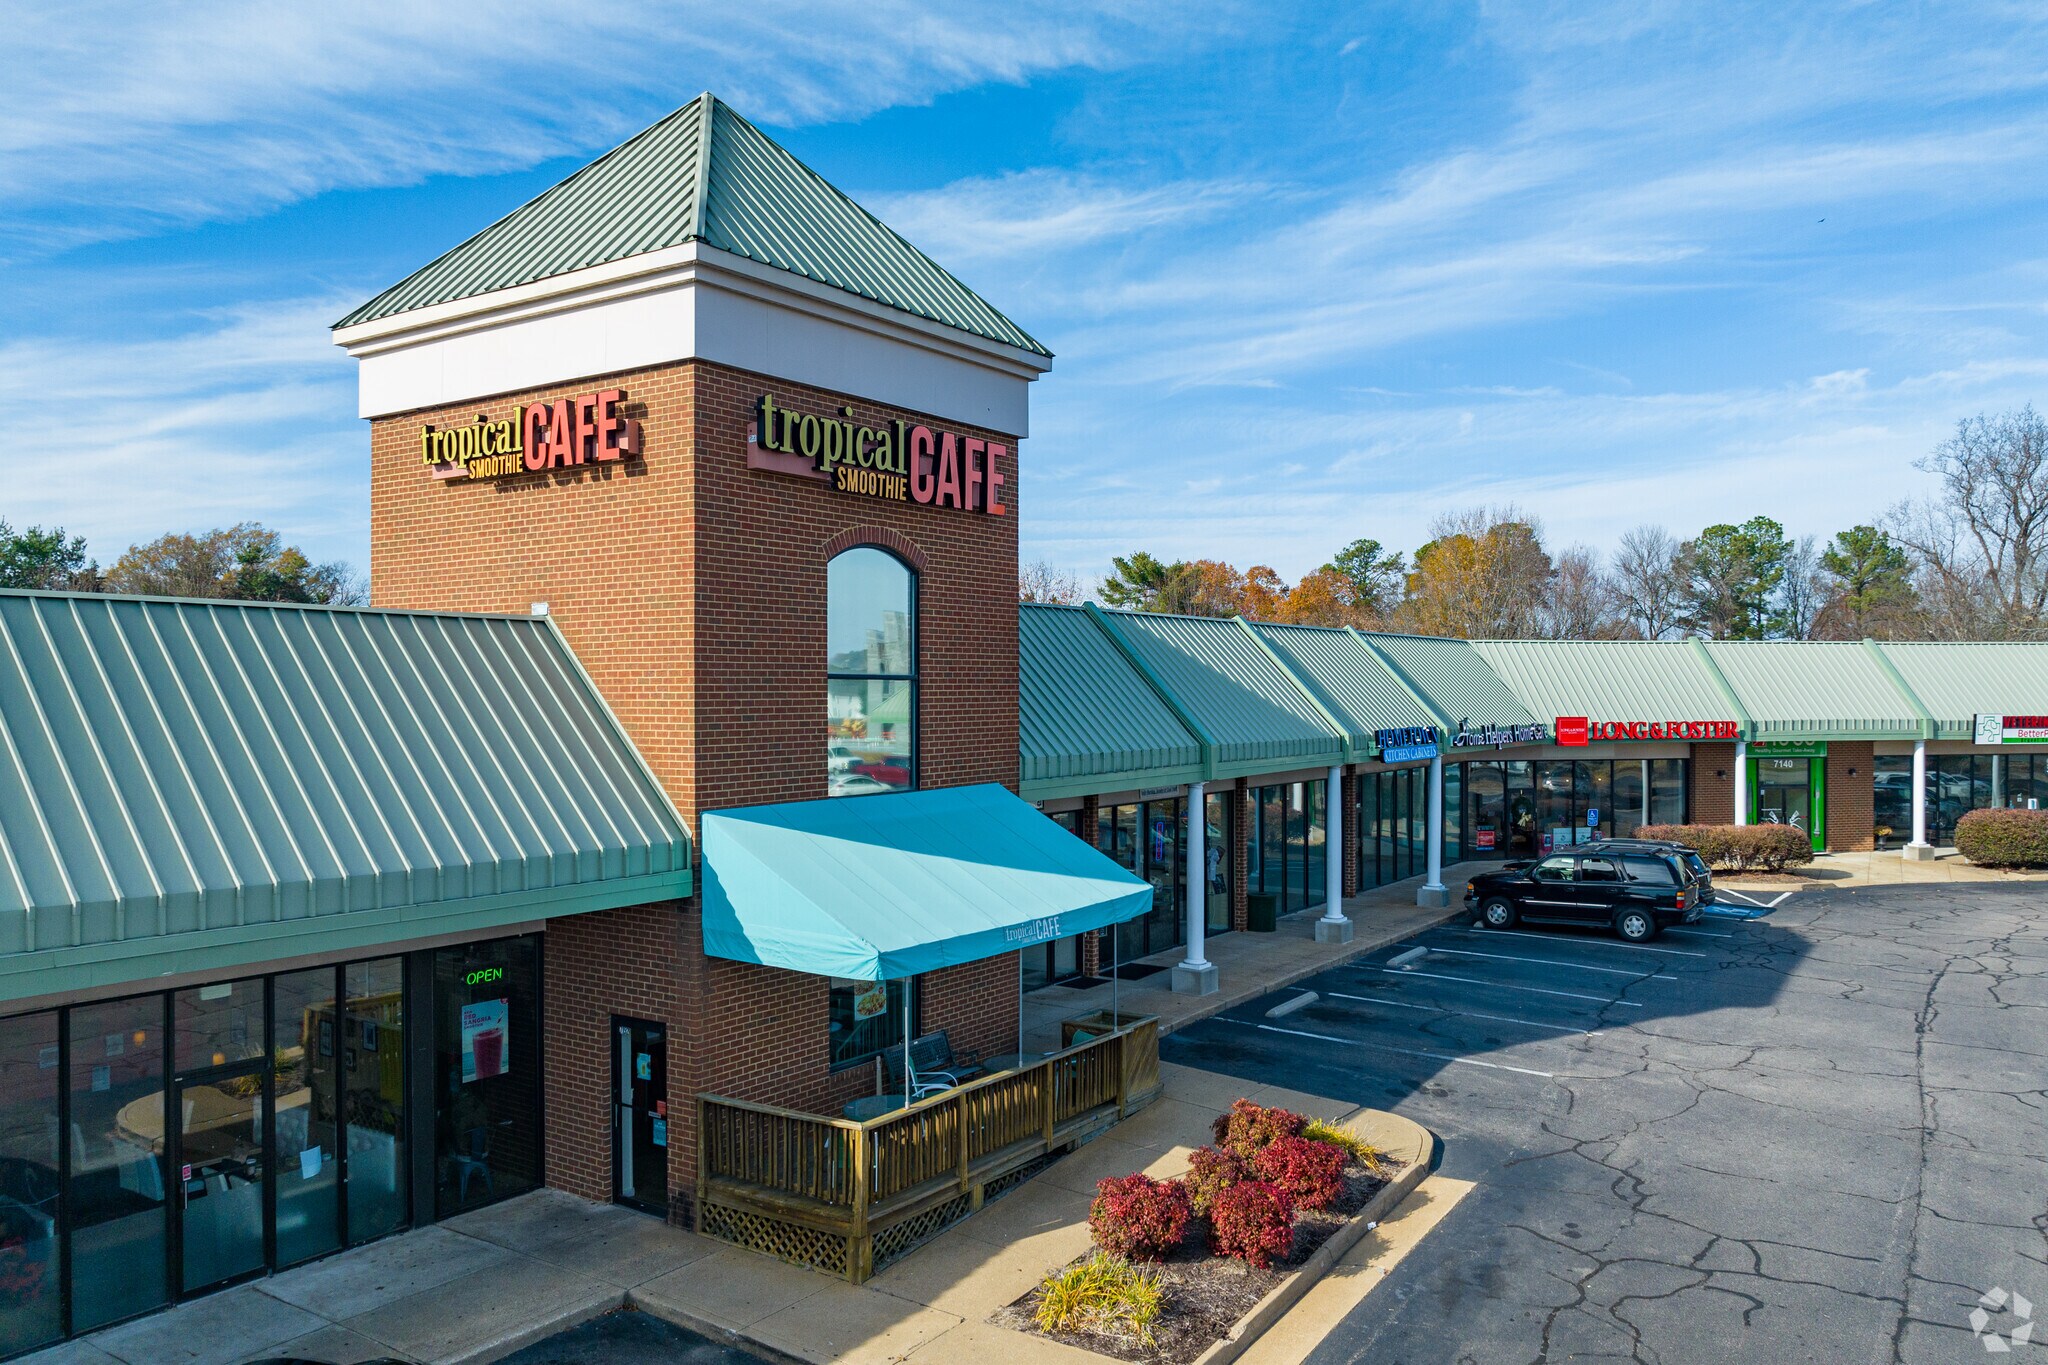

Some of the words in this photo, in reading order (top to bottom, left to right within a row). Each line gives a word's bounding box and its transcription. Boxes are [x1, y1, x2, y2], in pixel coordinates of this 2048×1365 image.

[420, 407, 523, 469] tropical
[523, 389, 622, 471] CAFE
[469, 453, 523, 480] SMOOTHIE
[758, 393, 908, 475] tropical
[910, 425, 1007, 516] CAFE
[837, 466, 907, 501] SMOOTHIE
[1379, 727, 1439, 749] HOMETOWN
[1485, 724, 1513, 750] Helpers
[1591, 721, 1649, 740] LONG
[1650, 721, 1663, 739] &
[1664, 720, 1740, 739] FOSTER
[1385, 749, 1410, 762] KITCHEN
[1411, 746, 1437, 759] CABINETS
[1773, 760, 1793, 768] 7140
[1006, 921, 1036, 941] tropical
[1036, 916, 1061, 939] CAFE
[466, 967, 502, 985] OPEN
